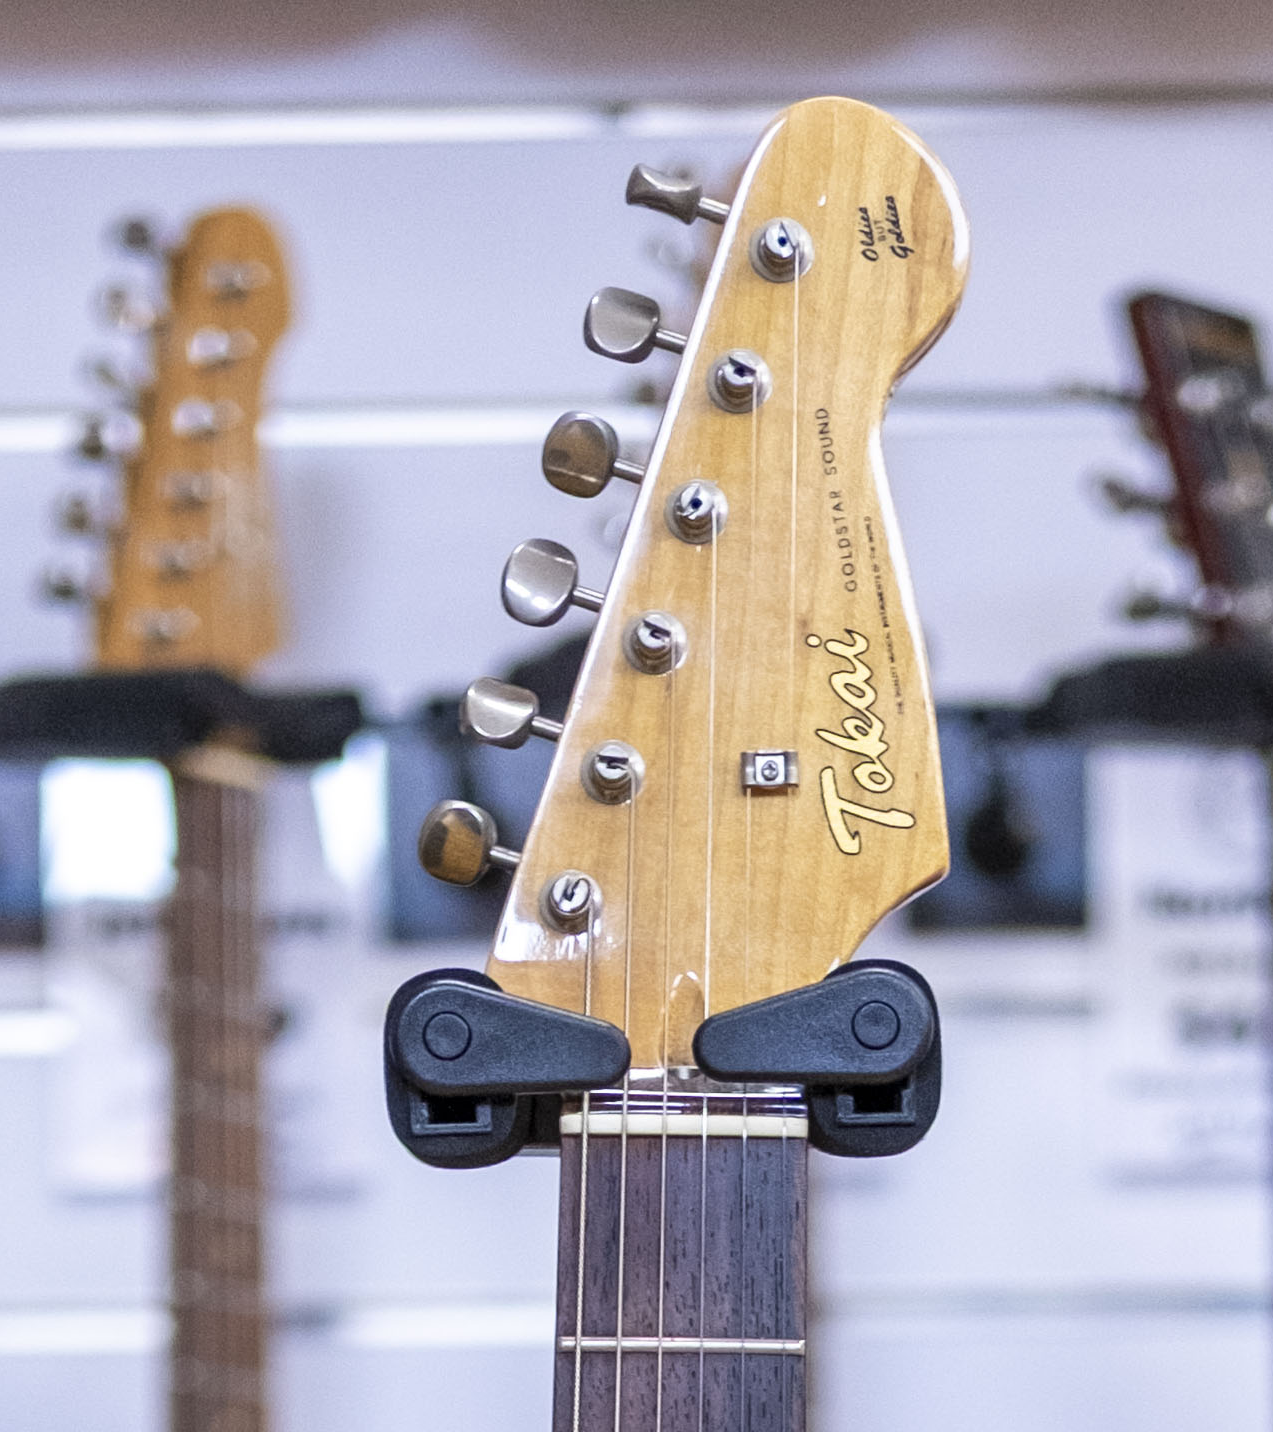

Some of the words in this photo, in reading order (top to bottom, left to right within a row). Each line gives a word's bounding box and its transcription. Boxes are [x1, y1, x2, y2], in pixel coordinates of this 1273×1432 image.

[858, 207, 879, 261] Oldies
[885, 195, 915, 258] Goldies
[815, 407, 838, 475] SOUND
[829, 489, 858, 592] GOLDSTAR
[805, 628, 917, 855] Tokai
